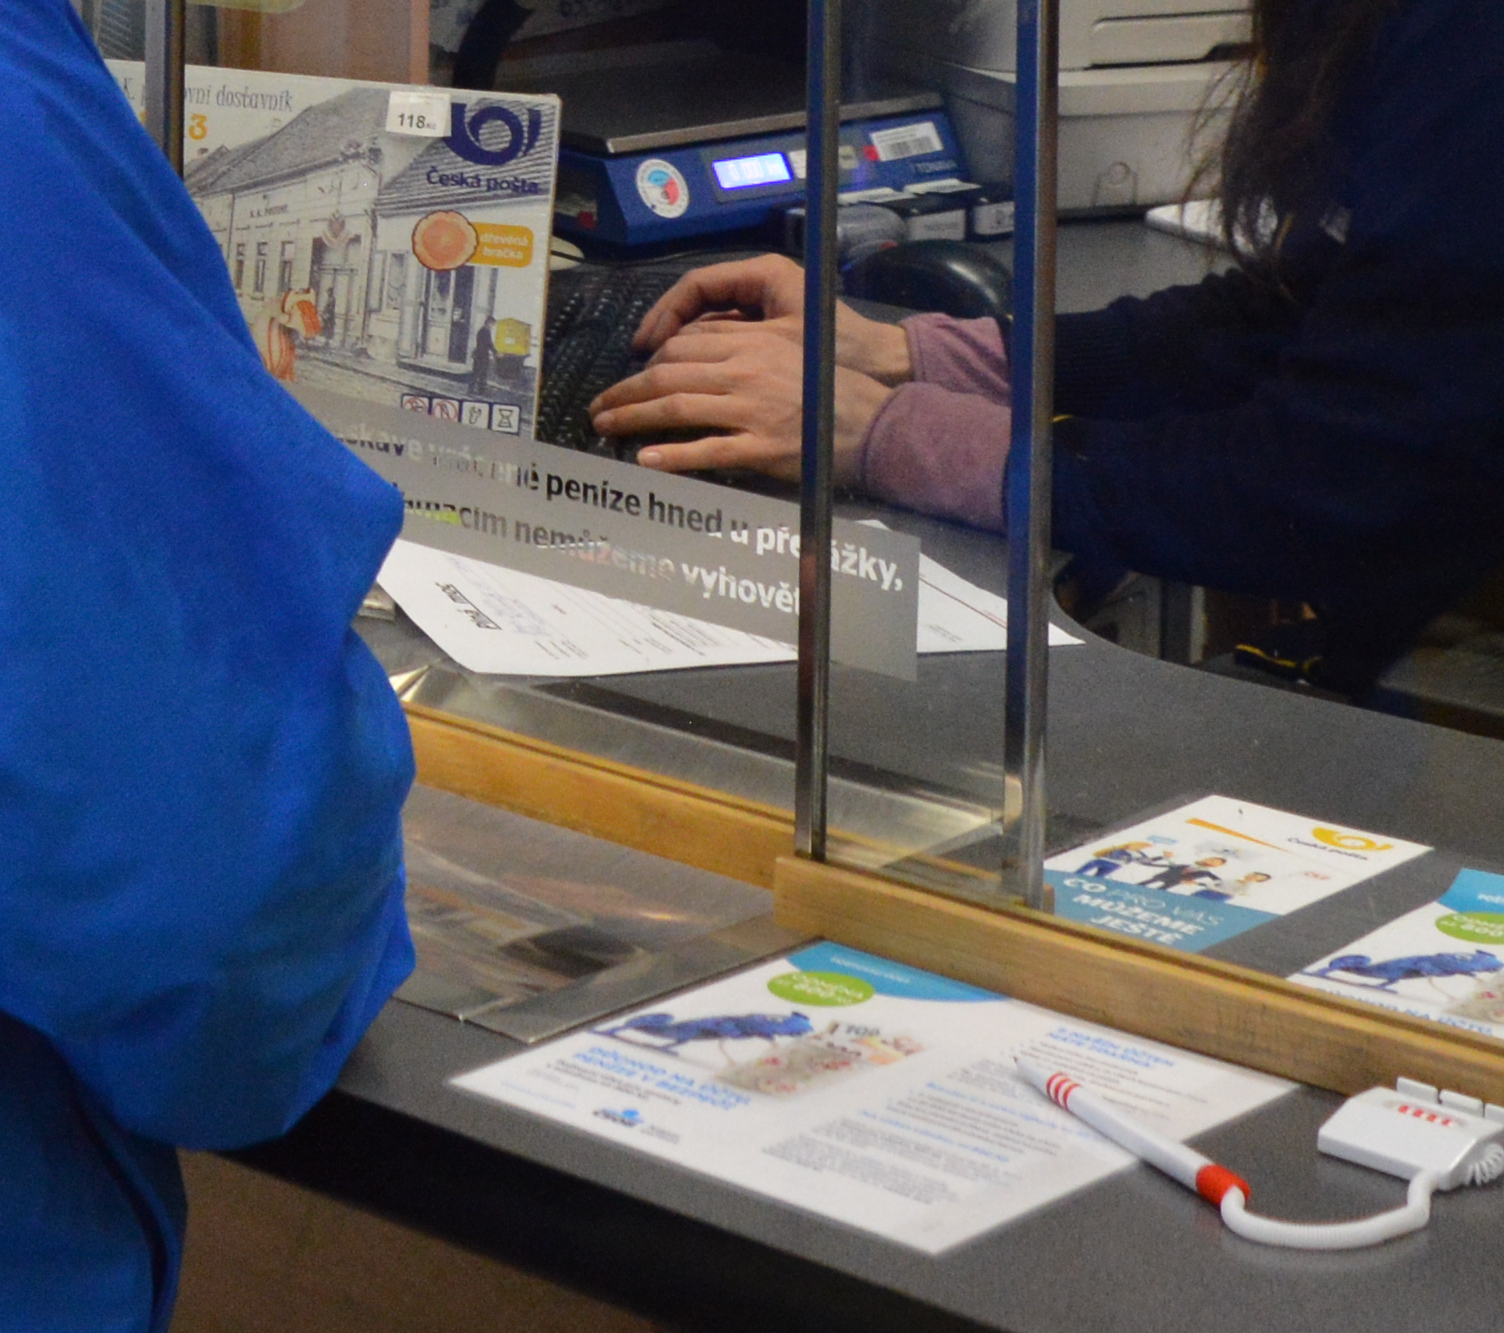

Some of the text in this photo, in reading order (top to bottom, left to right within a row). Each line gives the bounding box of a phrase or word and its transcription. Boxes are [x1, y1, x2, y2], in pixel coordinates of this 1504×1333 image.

[216, 85, 293, 112] dostavník
[398, 113, 427, 129] 118
[426, 166, 539, 195] Česká pošta
[546, 471, 641, 517] peníze
[649, 492, 722, 537] hned
[730, 518, 748, 545] u
[756, 524, 903, 592] přeážky,
[1062, 877, 1107, 893] CO
